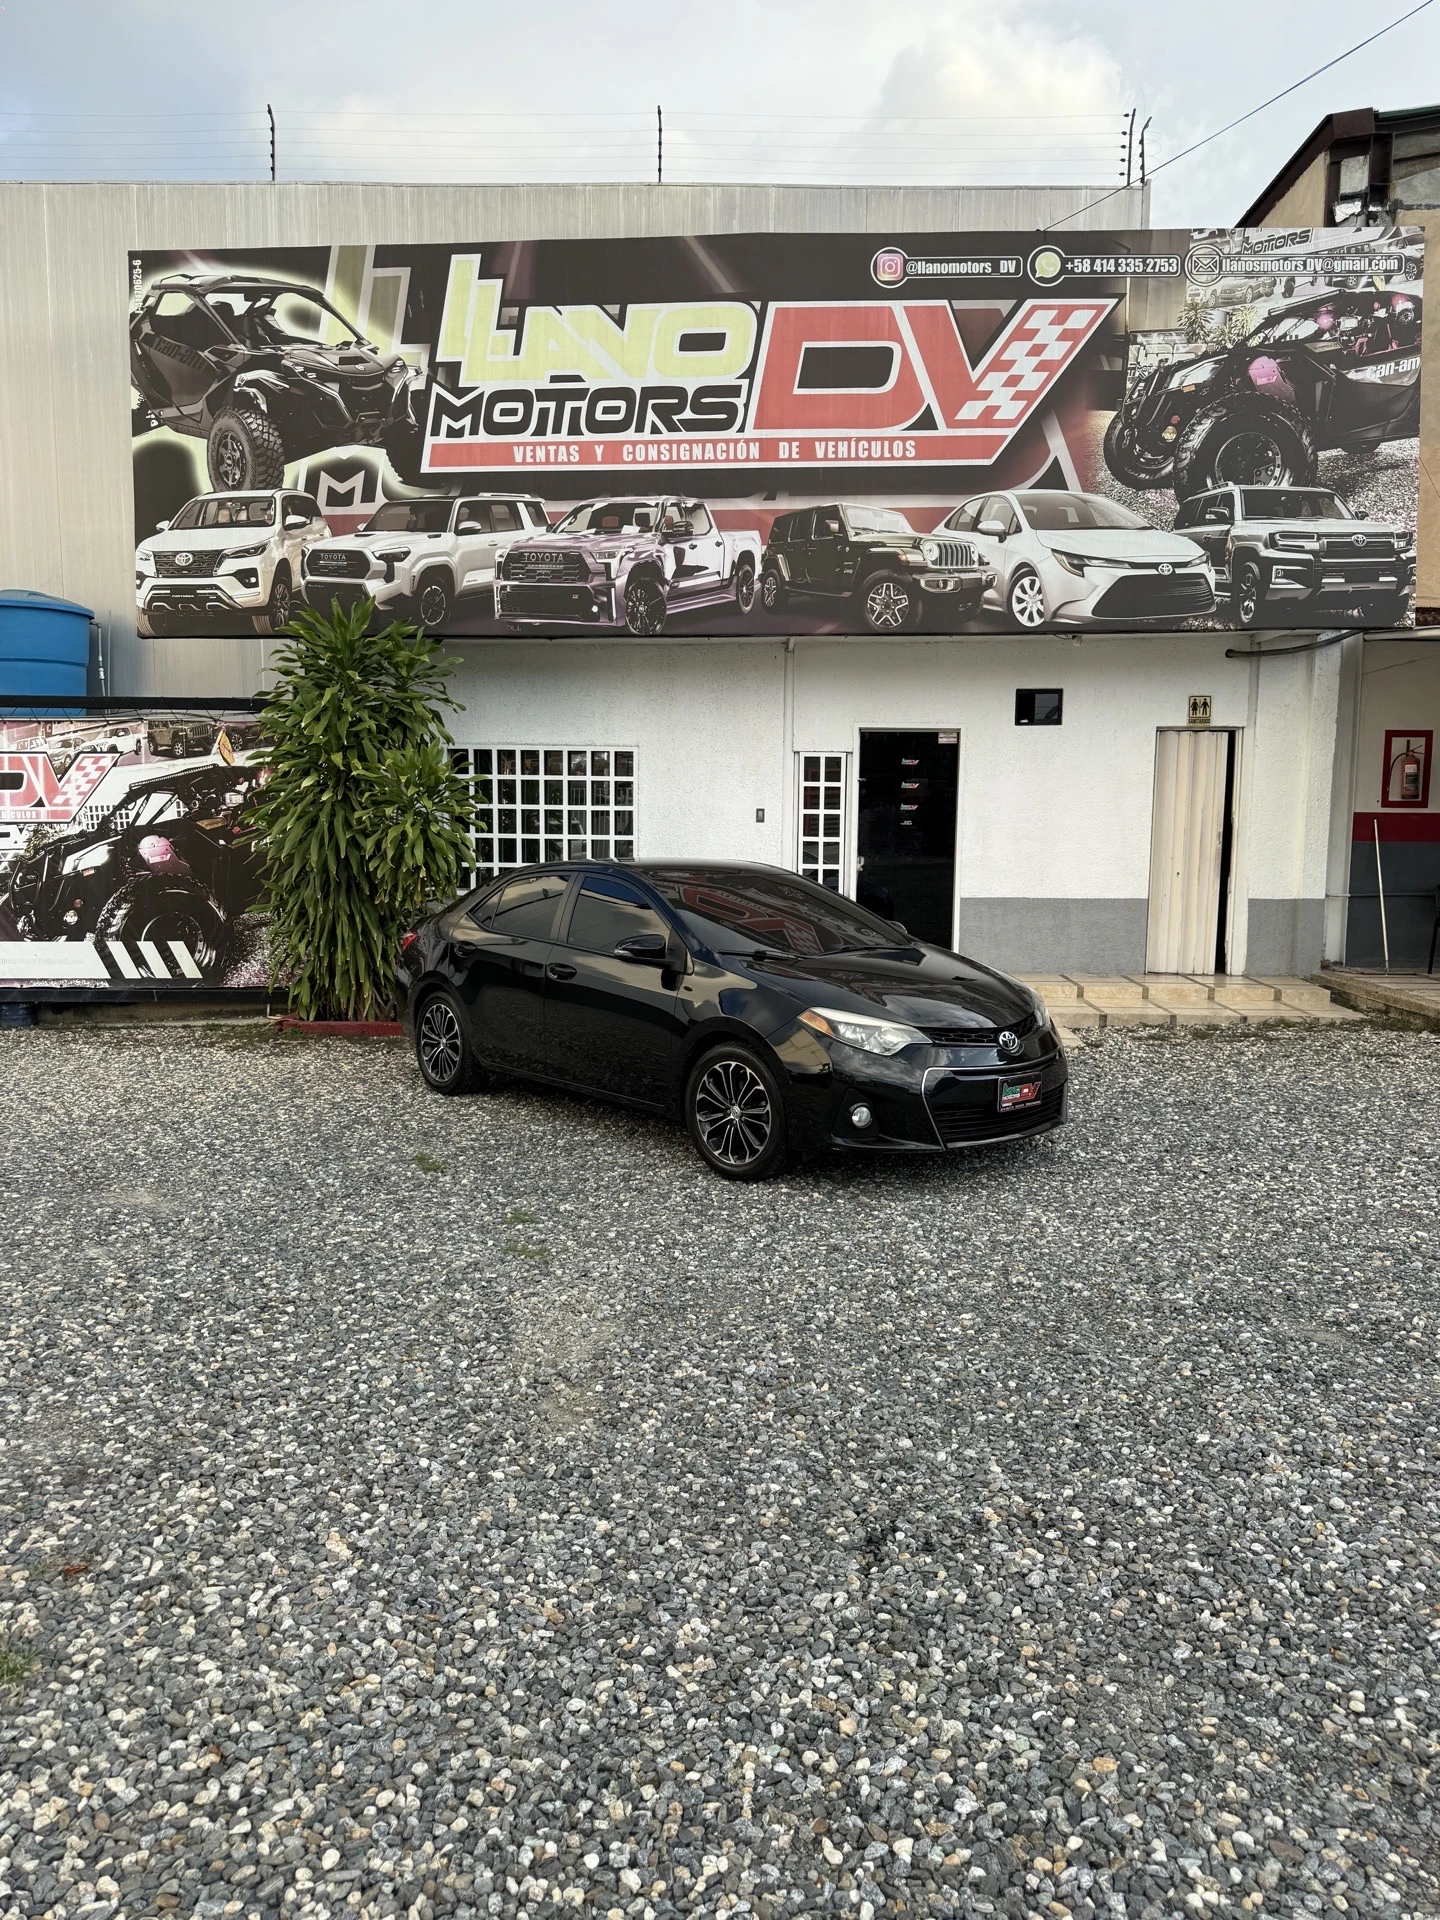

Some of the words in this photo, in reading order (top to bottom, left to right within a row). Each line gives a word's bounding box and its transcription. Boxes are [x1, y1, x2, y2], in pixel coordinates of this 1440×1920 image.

[905, 259, 1017, 276] @llanomotors_DV
[1065, 258, 1091, 273] +58
[1093, 258, 1115, 273] 414
[1145, 258, 1178, 273] 2753
[437, 254, 757, 386] LLANO
[750, 300, 1117, 430] DV
[430, 385, 748, 438] MOTORS
[513, 445, 579, 463] VENTAS
[594, 445, 604, 462] Y
[622, 440, 760, 461] CONSIGNACIÓN
[778, 442, 800, 458] DE
[815, 438, 916, 458] VEHÍCULOS
[523, 553, 564, 562] TOYOTA
